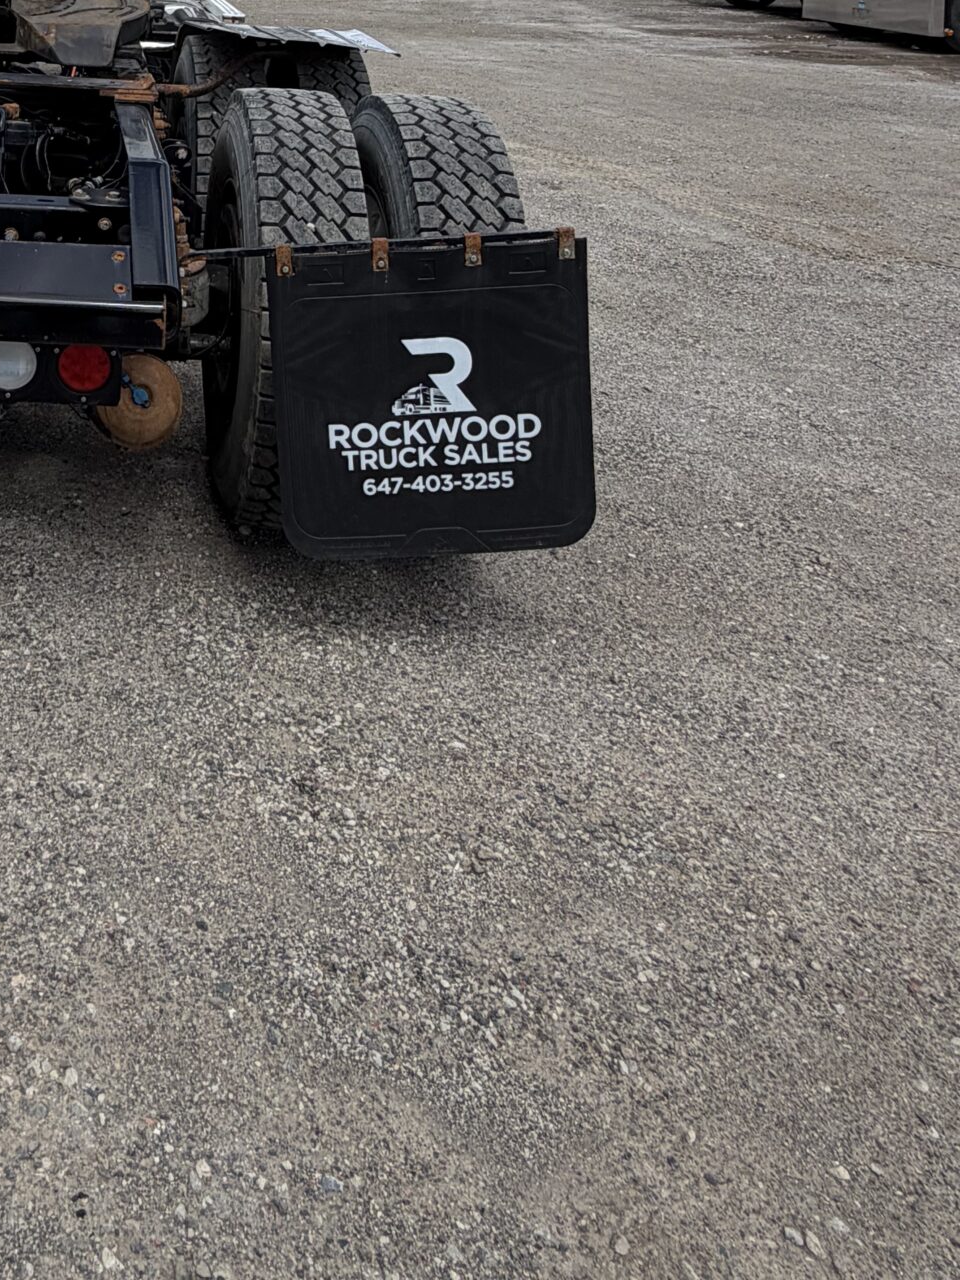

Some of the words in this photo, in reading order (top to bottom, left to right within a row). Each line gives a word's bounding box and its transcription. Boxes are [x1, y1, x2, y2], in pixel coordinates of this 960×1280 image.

[400, 336, 477, 413] R
[328, 413, 542, 450] ROCKWOOD
[341, 445, 438, 471] TRUCK
[443, 440, 532, 466] SALES
[362, 470, 515, 496] 647-403-3255
